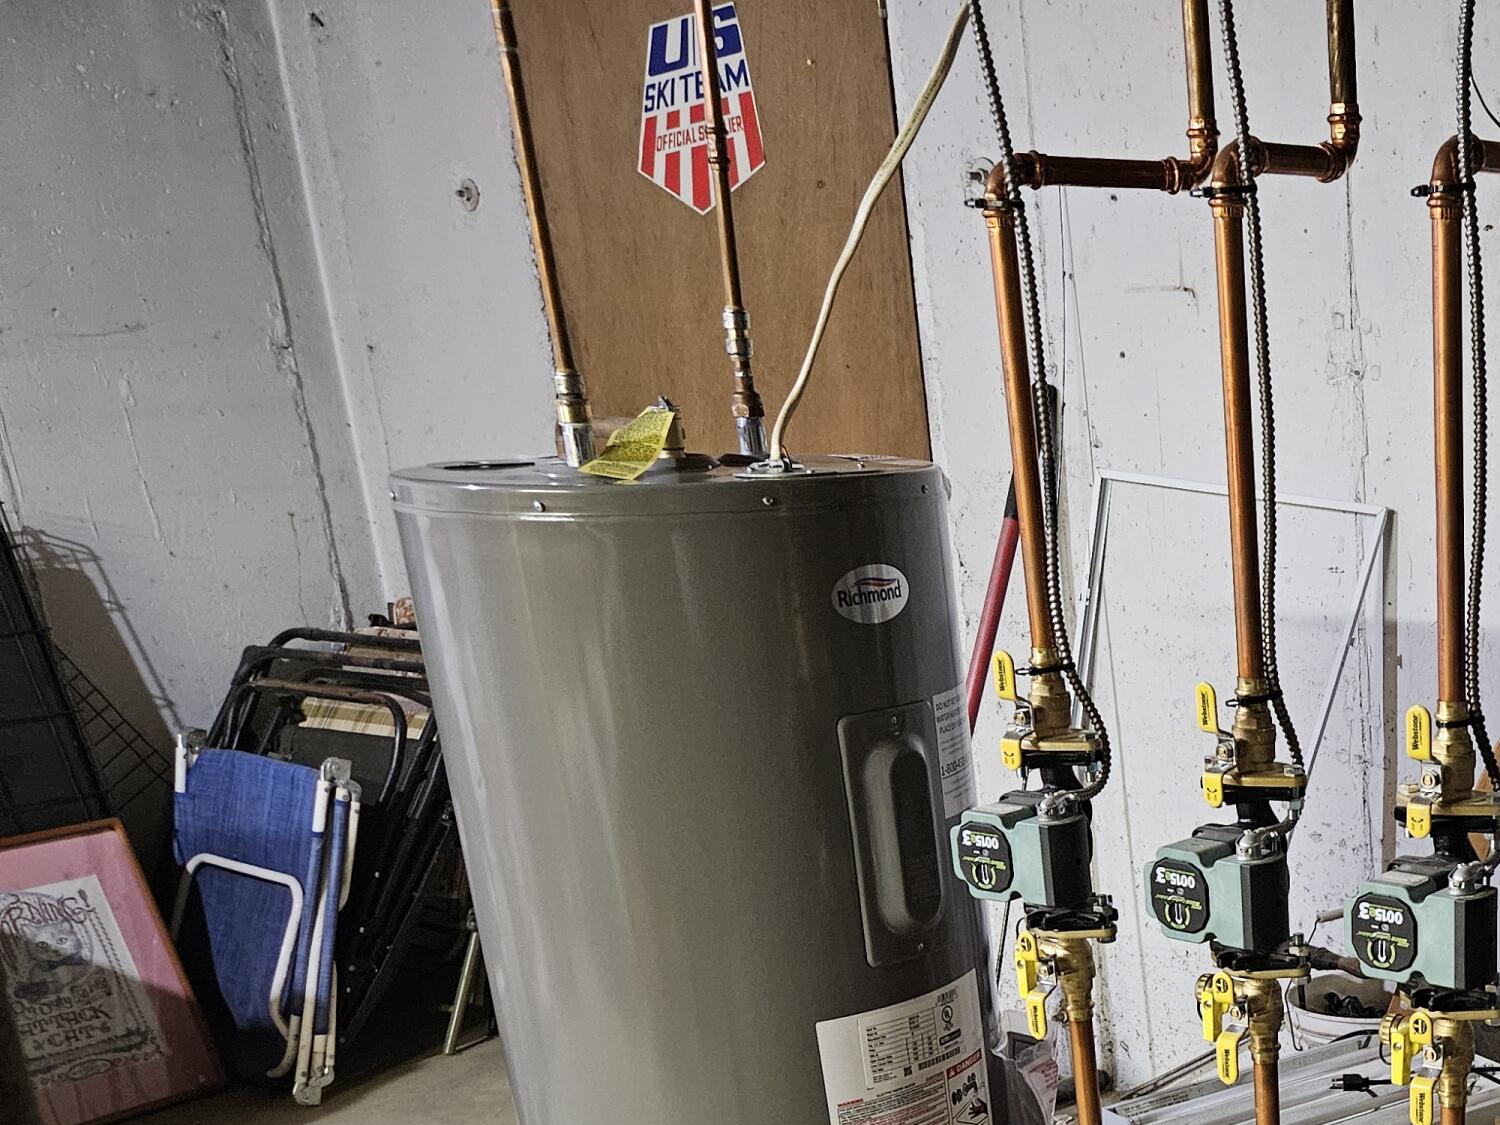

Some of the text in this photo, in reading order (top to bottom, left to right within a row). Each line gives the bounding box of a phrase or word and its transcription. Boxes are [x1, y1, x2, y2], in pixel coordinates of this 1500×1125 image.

[644, 77, 675, 113] SKI
[656, 115, 744, 152] OFFICIAL SIER
[837, 579, 902, 608] Richmond
[1412, 712, 1420, 751] Webstone
